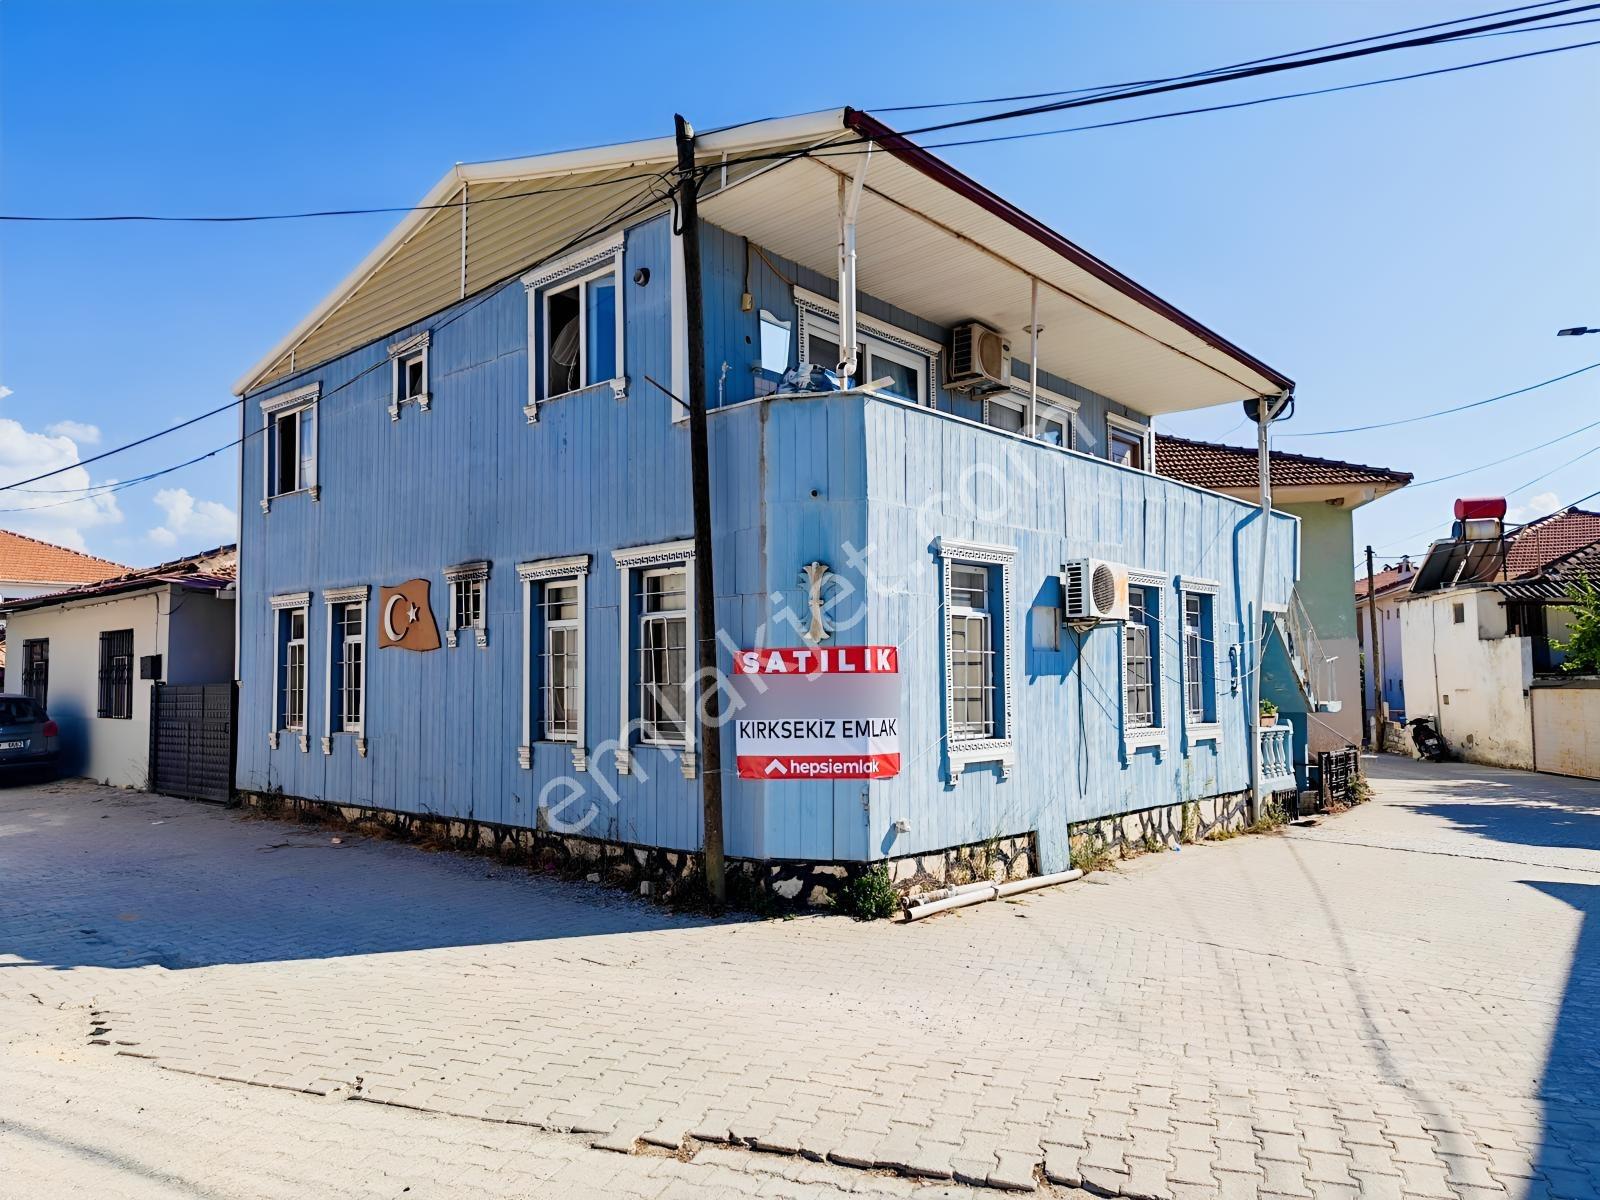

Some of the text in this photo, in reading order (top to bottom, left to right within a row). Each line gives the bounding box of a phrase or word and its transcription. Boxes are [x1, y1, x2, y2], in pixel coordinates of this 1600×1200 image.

[742, 649, 891, 673] SATILIK
[740, 719, 897, 739] KIRKSEKİZ EMLAK
[790, 758, 880, 776] hepsiemlak
